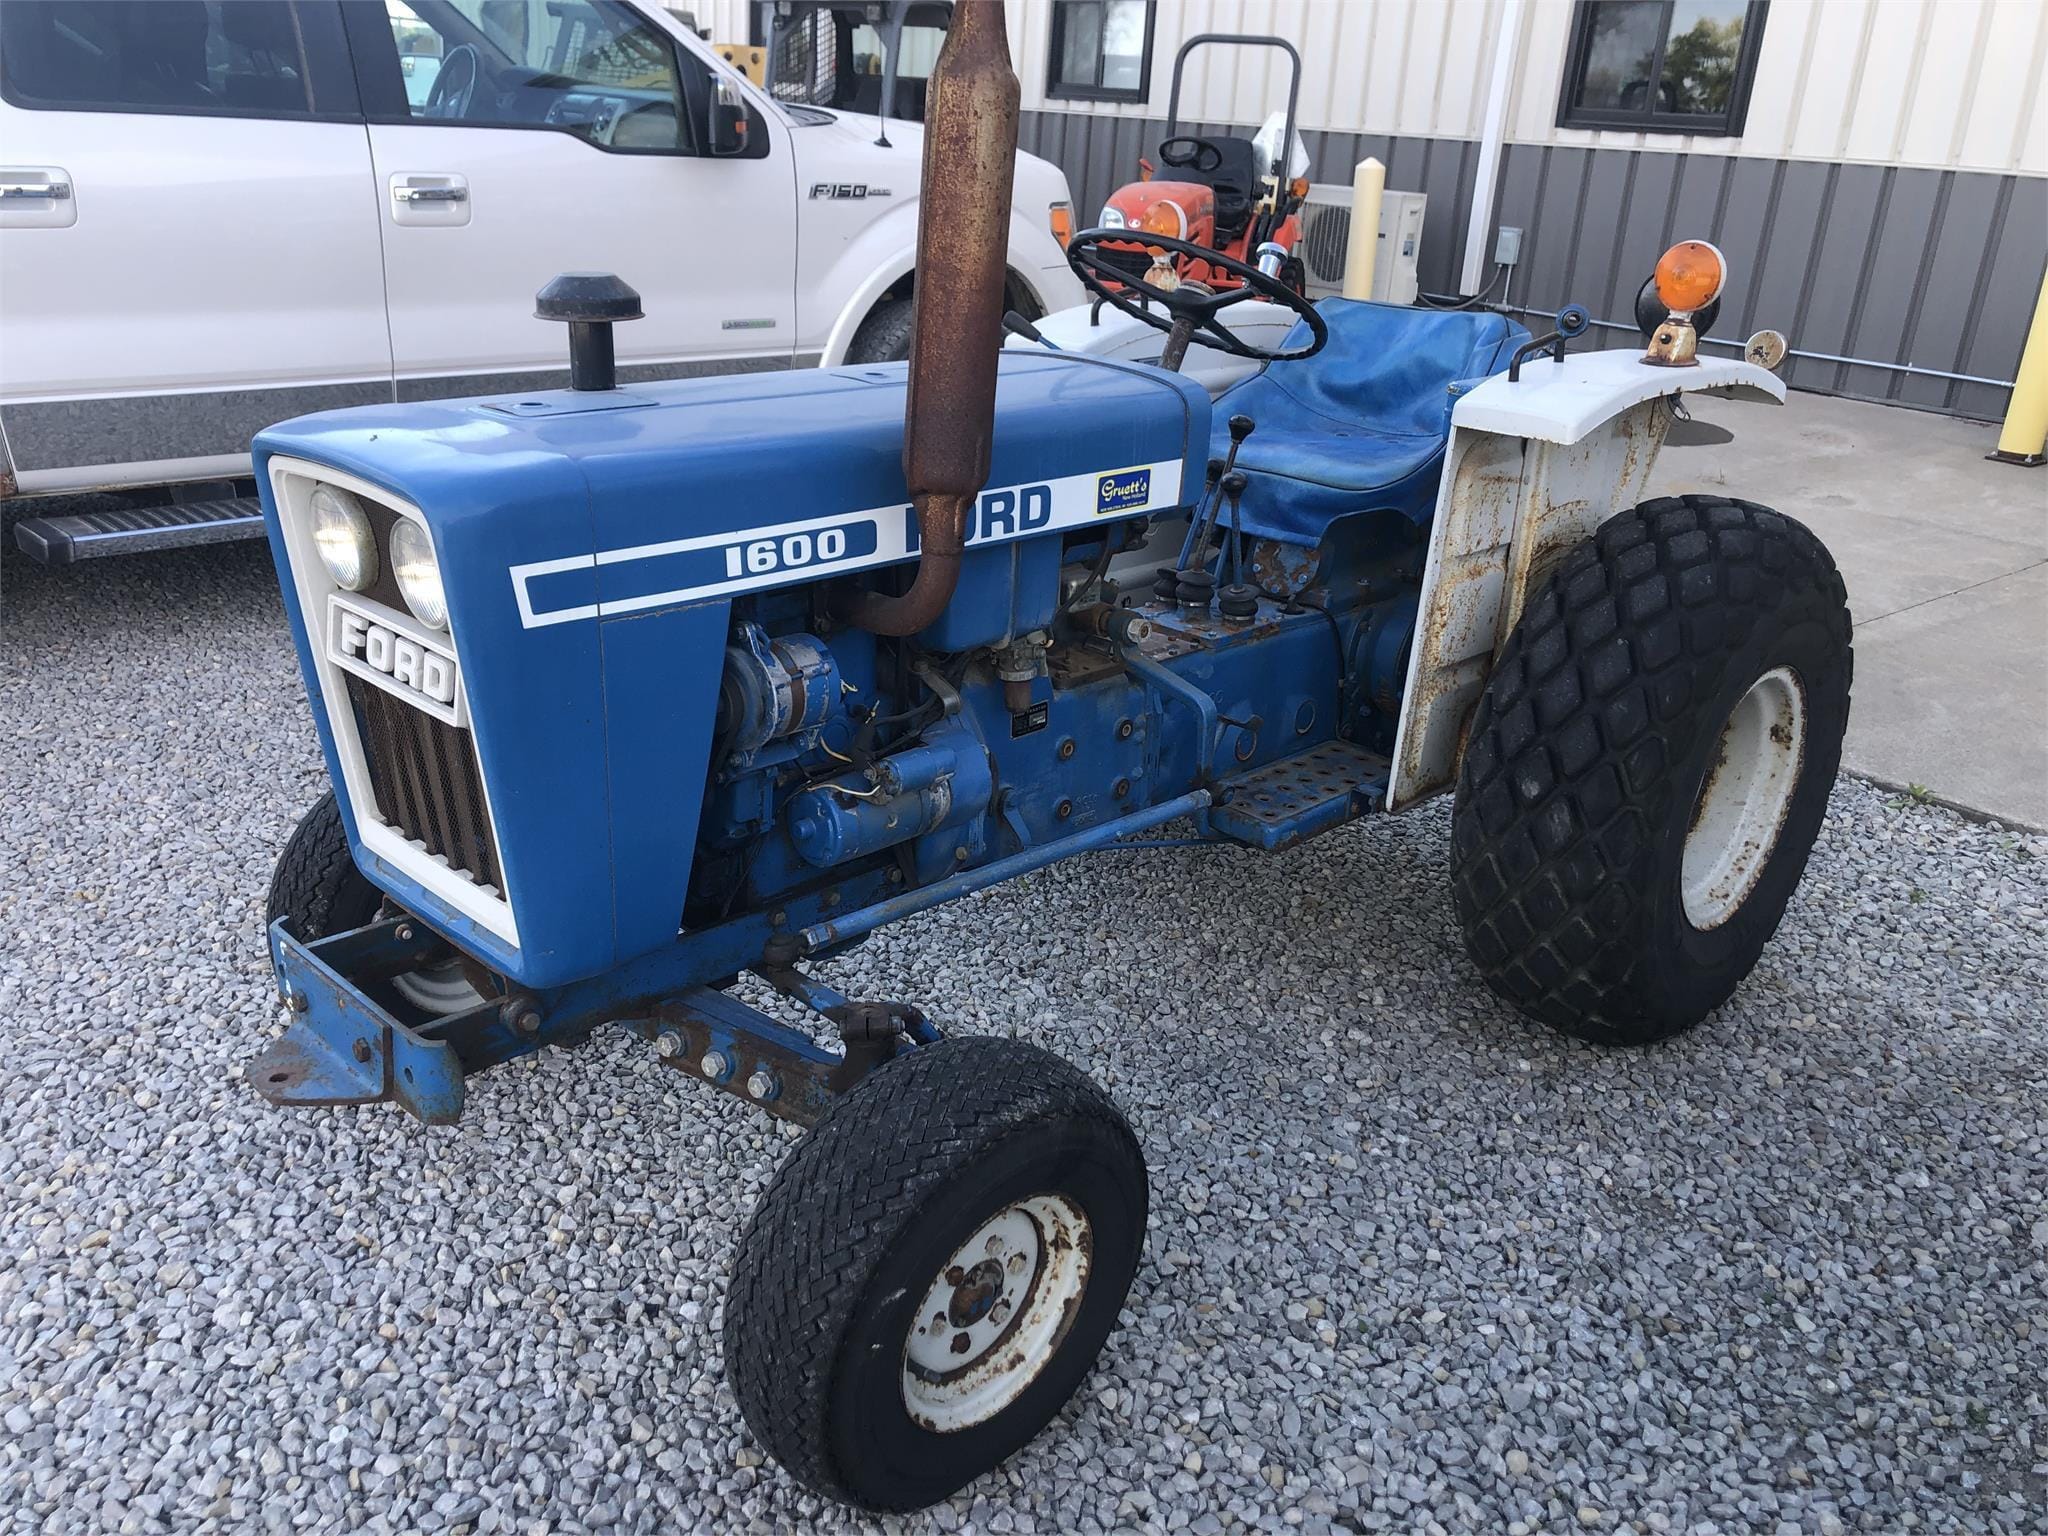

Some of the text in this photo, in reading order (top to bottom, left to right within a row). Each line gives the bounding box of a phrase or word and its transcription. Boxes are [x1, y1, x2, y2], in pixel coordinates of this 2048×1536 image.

[808, 184, 867, 199] F-150
[1102, 477, 1147, 501] Gruett's
[726, 529, 846, 578] 1600
[341, 611, 456, 703] FORD
